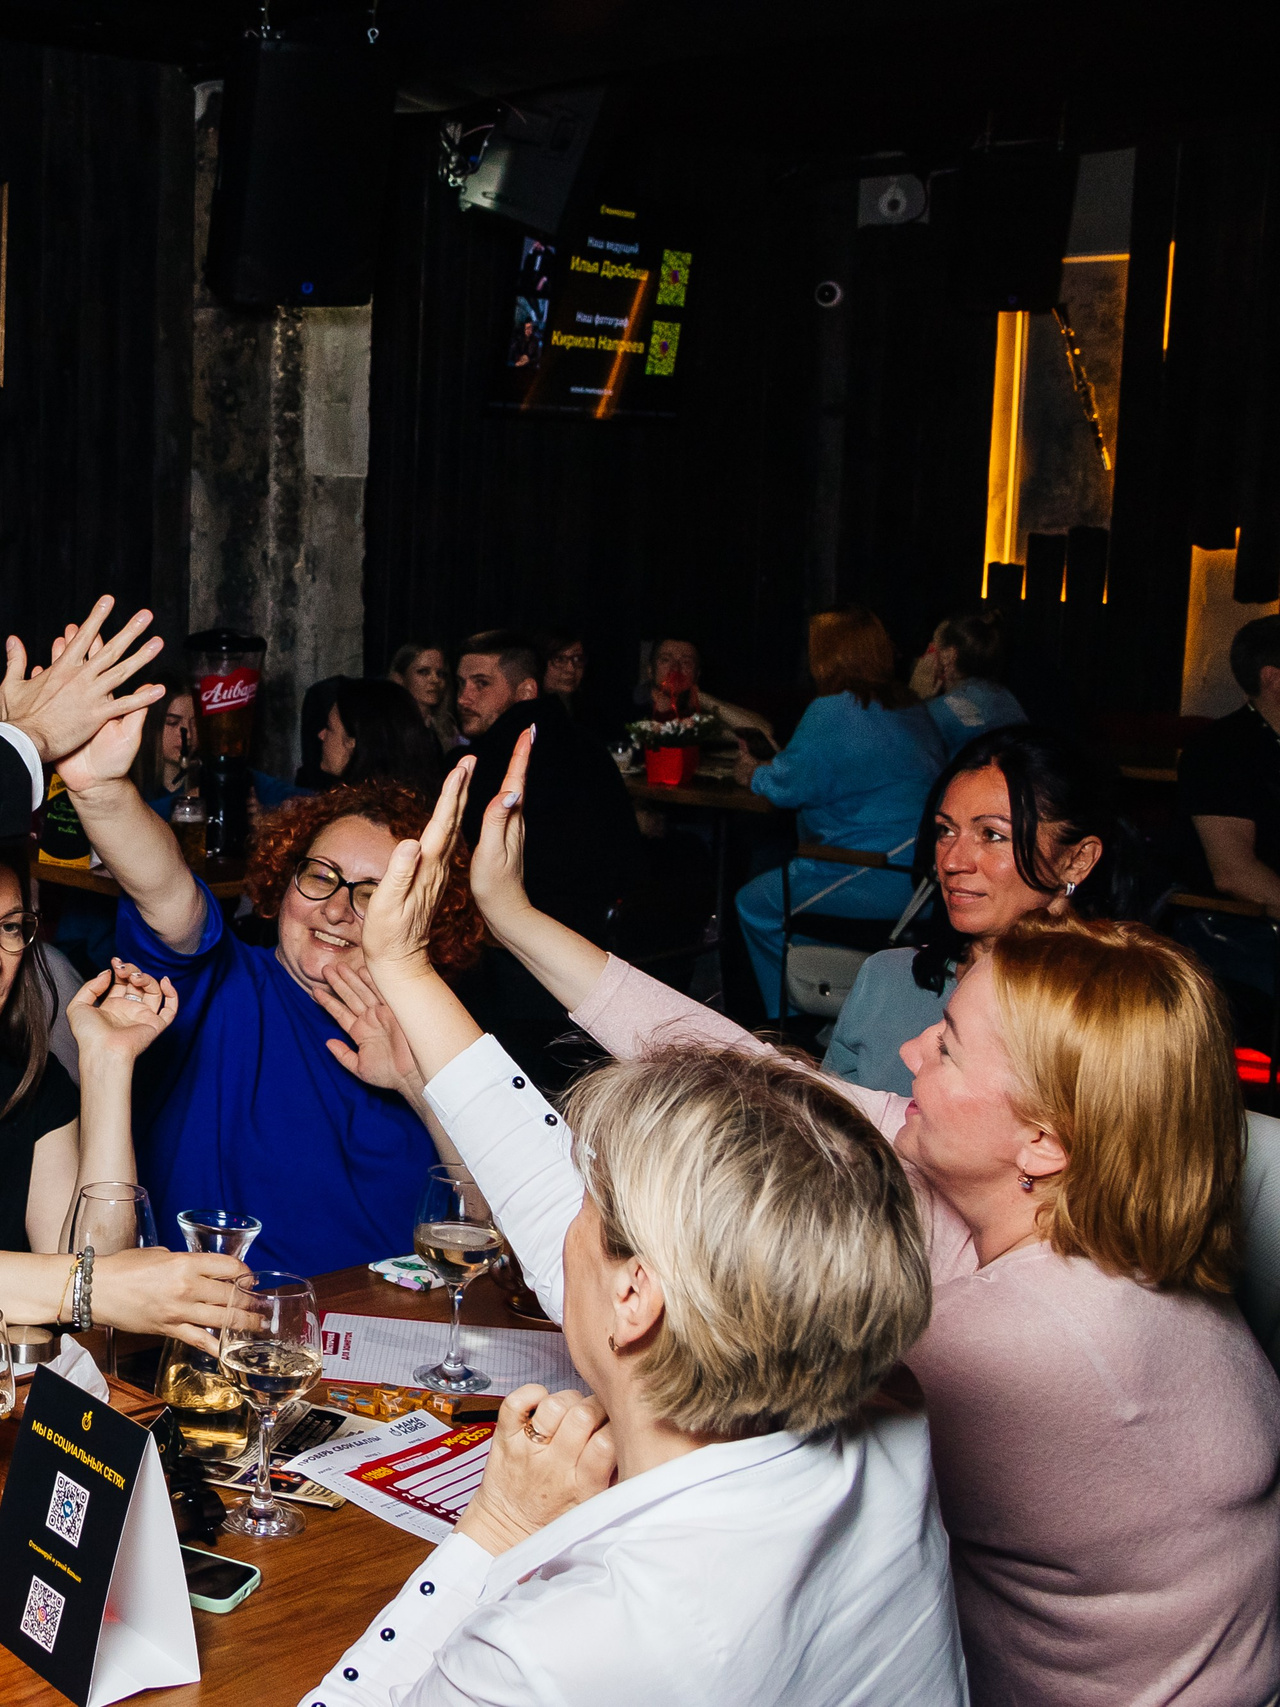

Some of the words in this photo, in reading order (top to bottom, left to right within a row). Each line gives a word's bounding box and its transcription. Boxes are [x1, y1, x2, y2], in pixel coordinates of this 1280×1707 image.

[570, 255, 600, 274] Илья
[551, 330, 596, 350] Кирилл
[394, 1416, 421, 1430] МАМА
[401, 1421, 429, 1435] КВИЗ!
[32, 1419, 47, 1437] МЫ
[46, 1428, 54, 1441] В
[53, 1433, 104, 1475] СОЦИАЛЬНЫХ
[103, 1466, 126, 1490] СЕТЯХ
[297, 1449, 334, 1467] ПРОВЕРЬ
[332, 1441, 355, 1453] СВОИ
[353, 1435, 382, 1447] БАЛЛЫ
